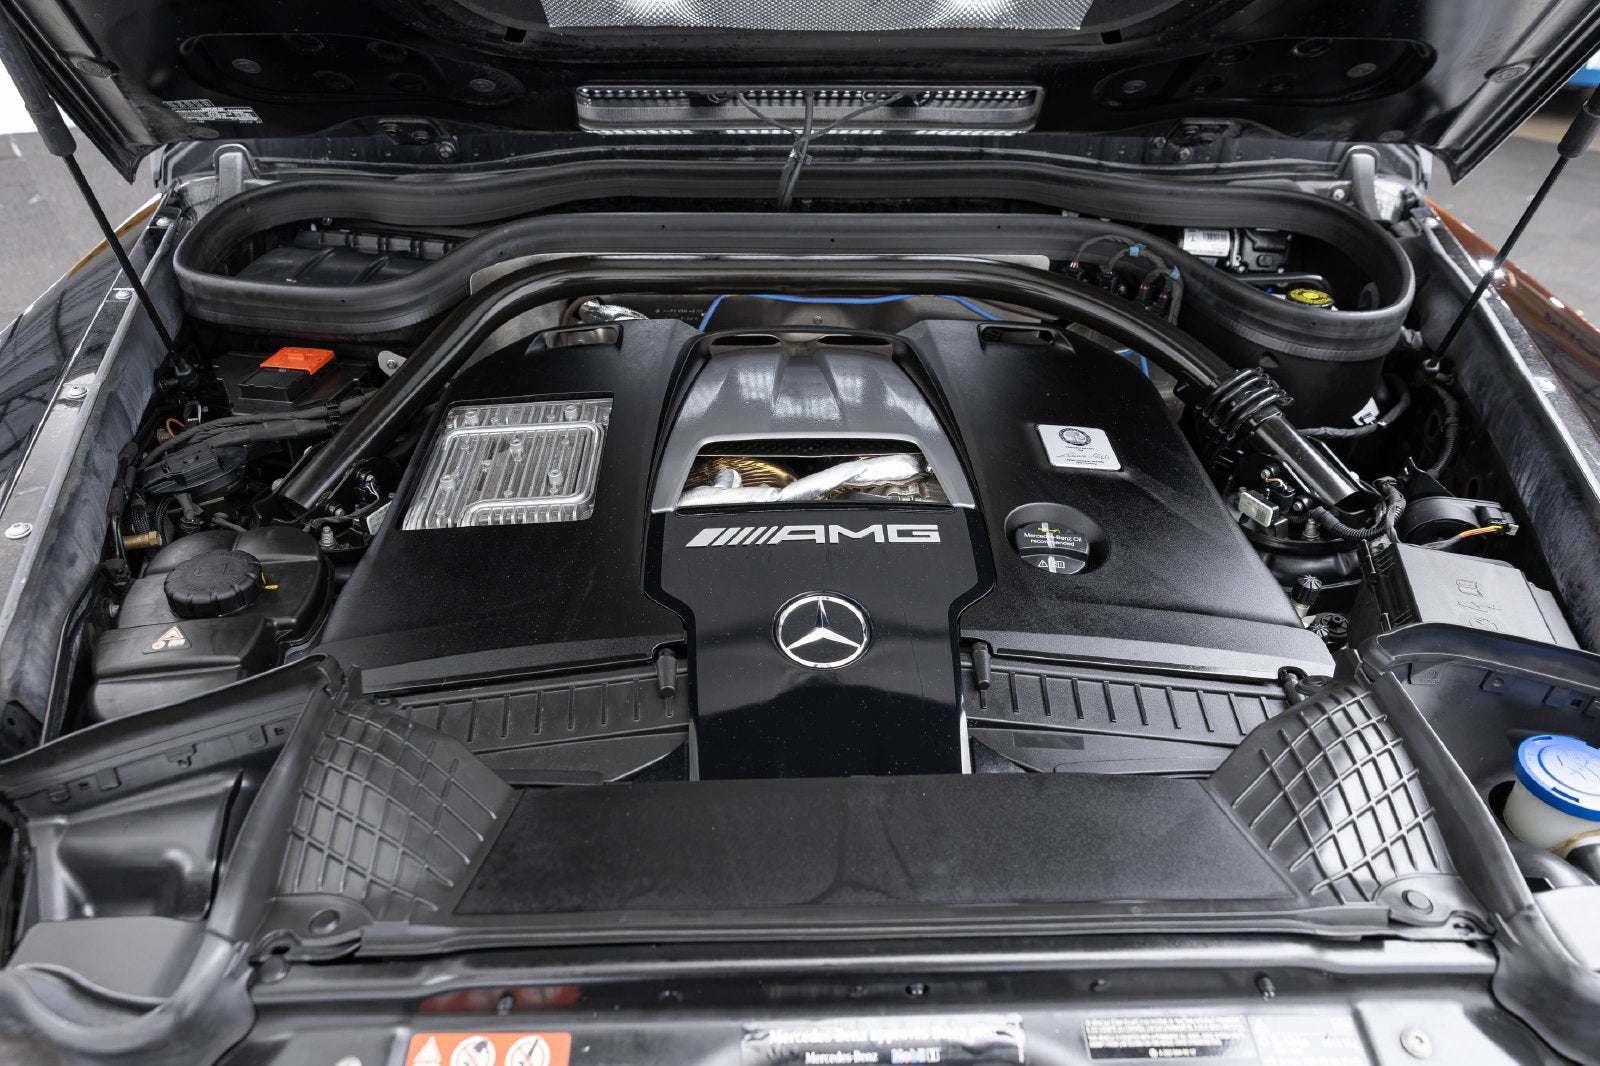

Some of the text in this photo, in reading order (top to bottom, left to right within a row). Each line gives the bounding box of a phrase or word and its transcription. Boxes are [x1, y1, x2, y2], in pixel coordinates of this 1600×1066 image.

[767, 524, 941, 545] AMG
[1023, 532, 1072, 541] Merced-Benz
[1030, 538, 1075, 547] recomended
[769, 1027, 867, 1045] Mercedes-Benz
[805, 1050, 878, 1065] Mercedes-Benz
